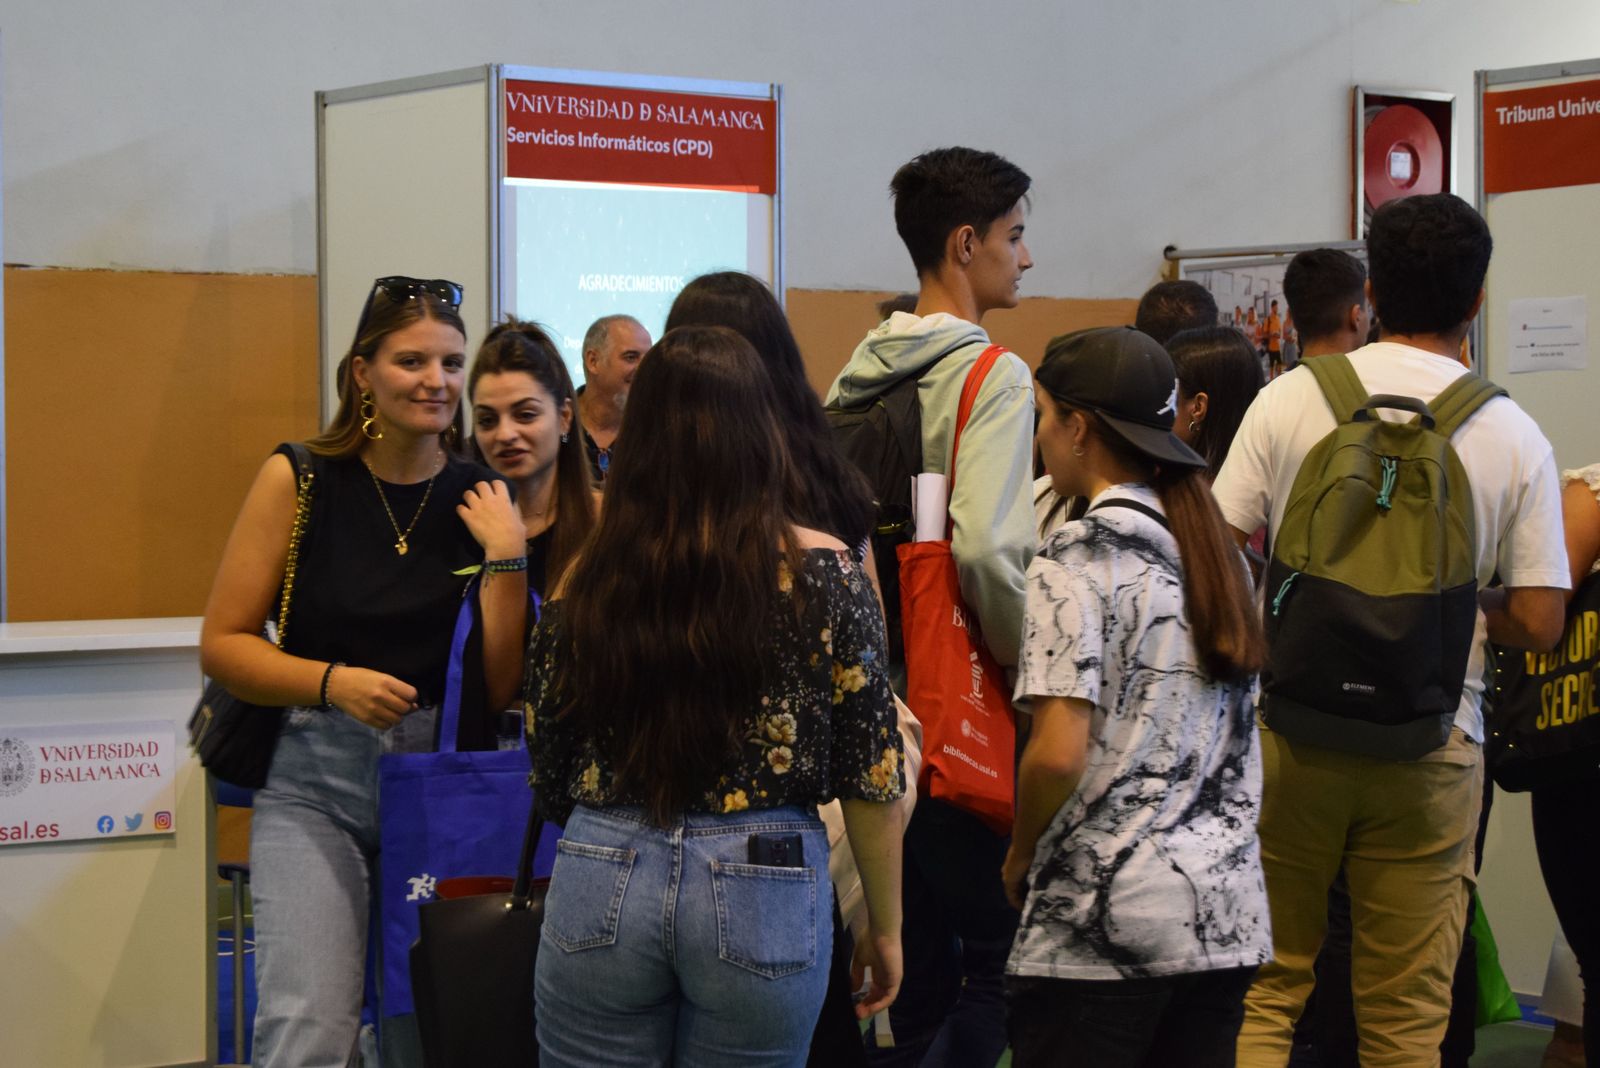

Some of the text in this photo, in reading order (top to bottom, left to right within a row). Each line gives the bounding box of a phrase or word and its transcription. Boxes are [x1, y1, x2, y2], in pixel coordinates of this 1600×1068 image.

[657, 104, 764, 130] SALAMANCA
[1495, 105, 1555, 125] Tribuna
[506, 127, 713, 158] Servicios Informáticos (CPD)
[578, 273, 685, 292] AGRADECIMIENTOS
[54, 762, 161, 783] SALAMANCA
